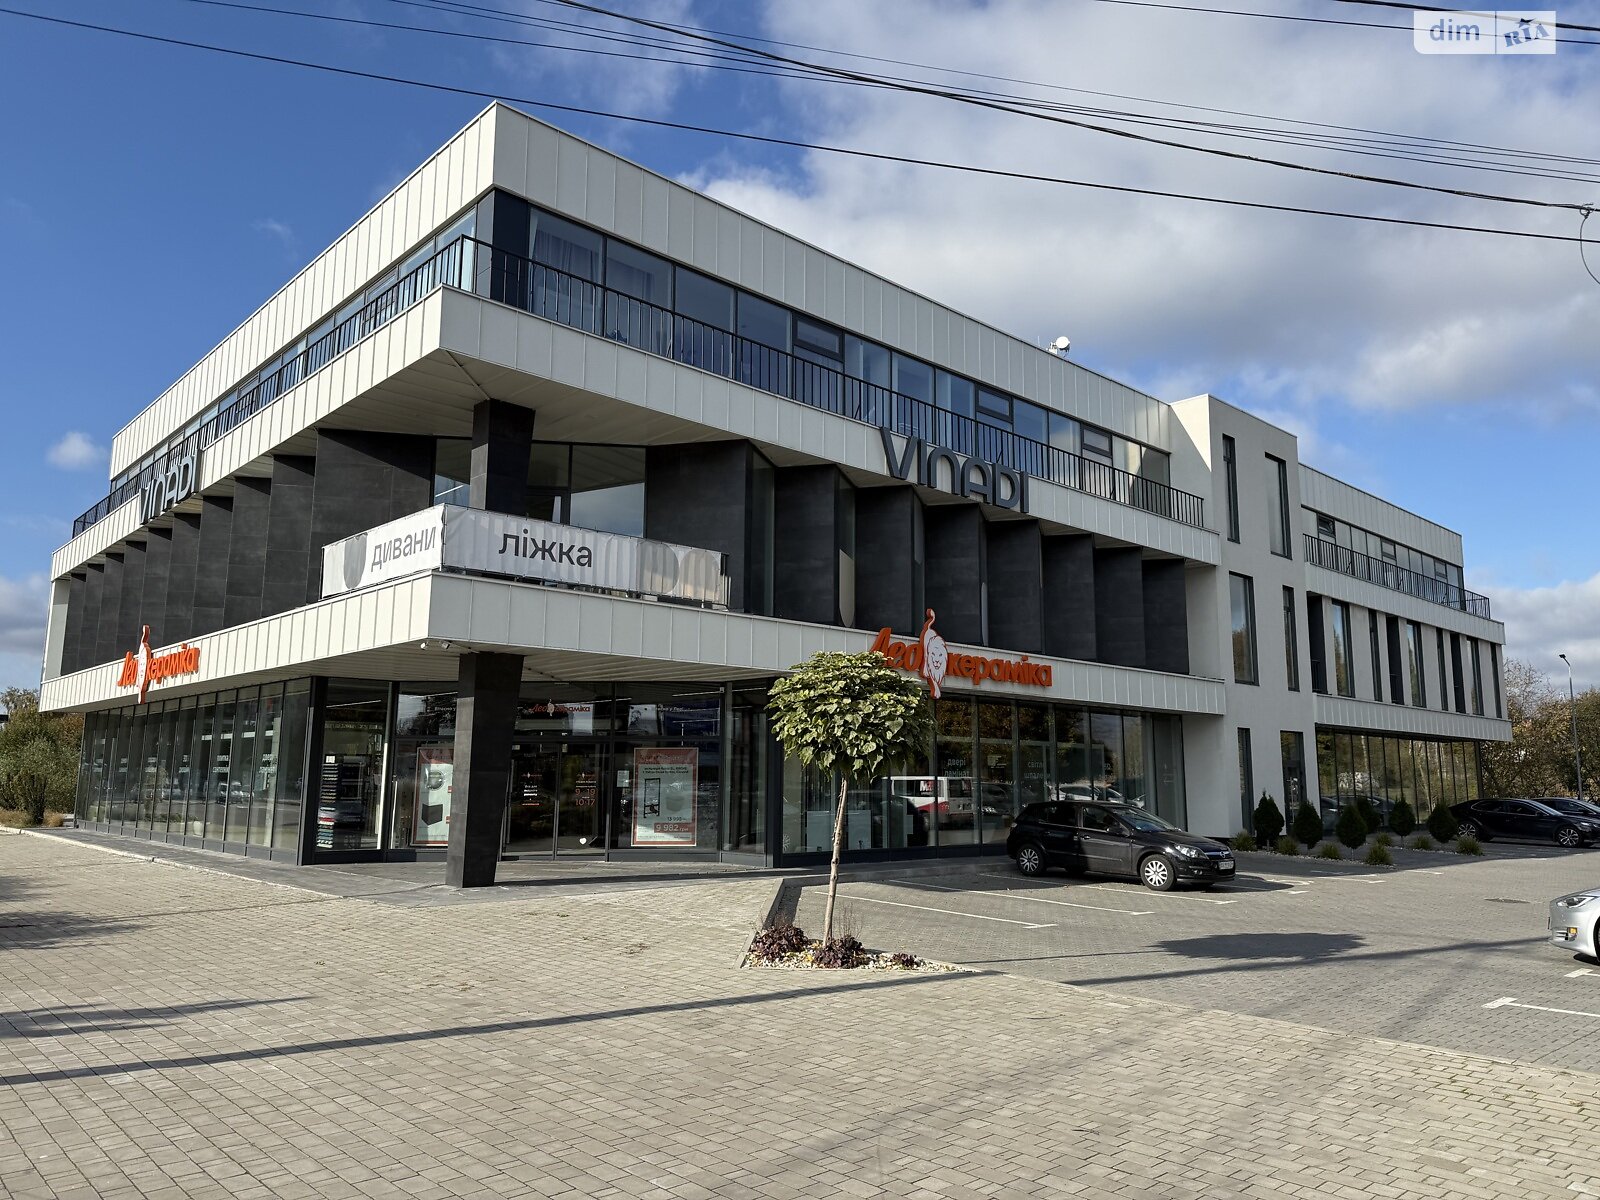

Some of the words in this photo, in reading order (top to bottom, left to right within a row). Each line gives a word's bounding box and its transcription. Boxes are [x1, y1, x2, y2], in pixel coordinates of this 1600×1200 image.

[139, 449, 202, 525] VINADI
[880, 426, 1029, 514] VINADI
[371, 526, 436, 573] дивани
[498, 528, 592, 568] ліжка
[147, 643, 200, 684] кераміка
[946, 655, 1052, 687] кераміка
[947, 757, 966, 767] двері
[663, 824, 679, 832] 982
